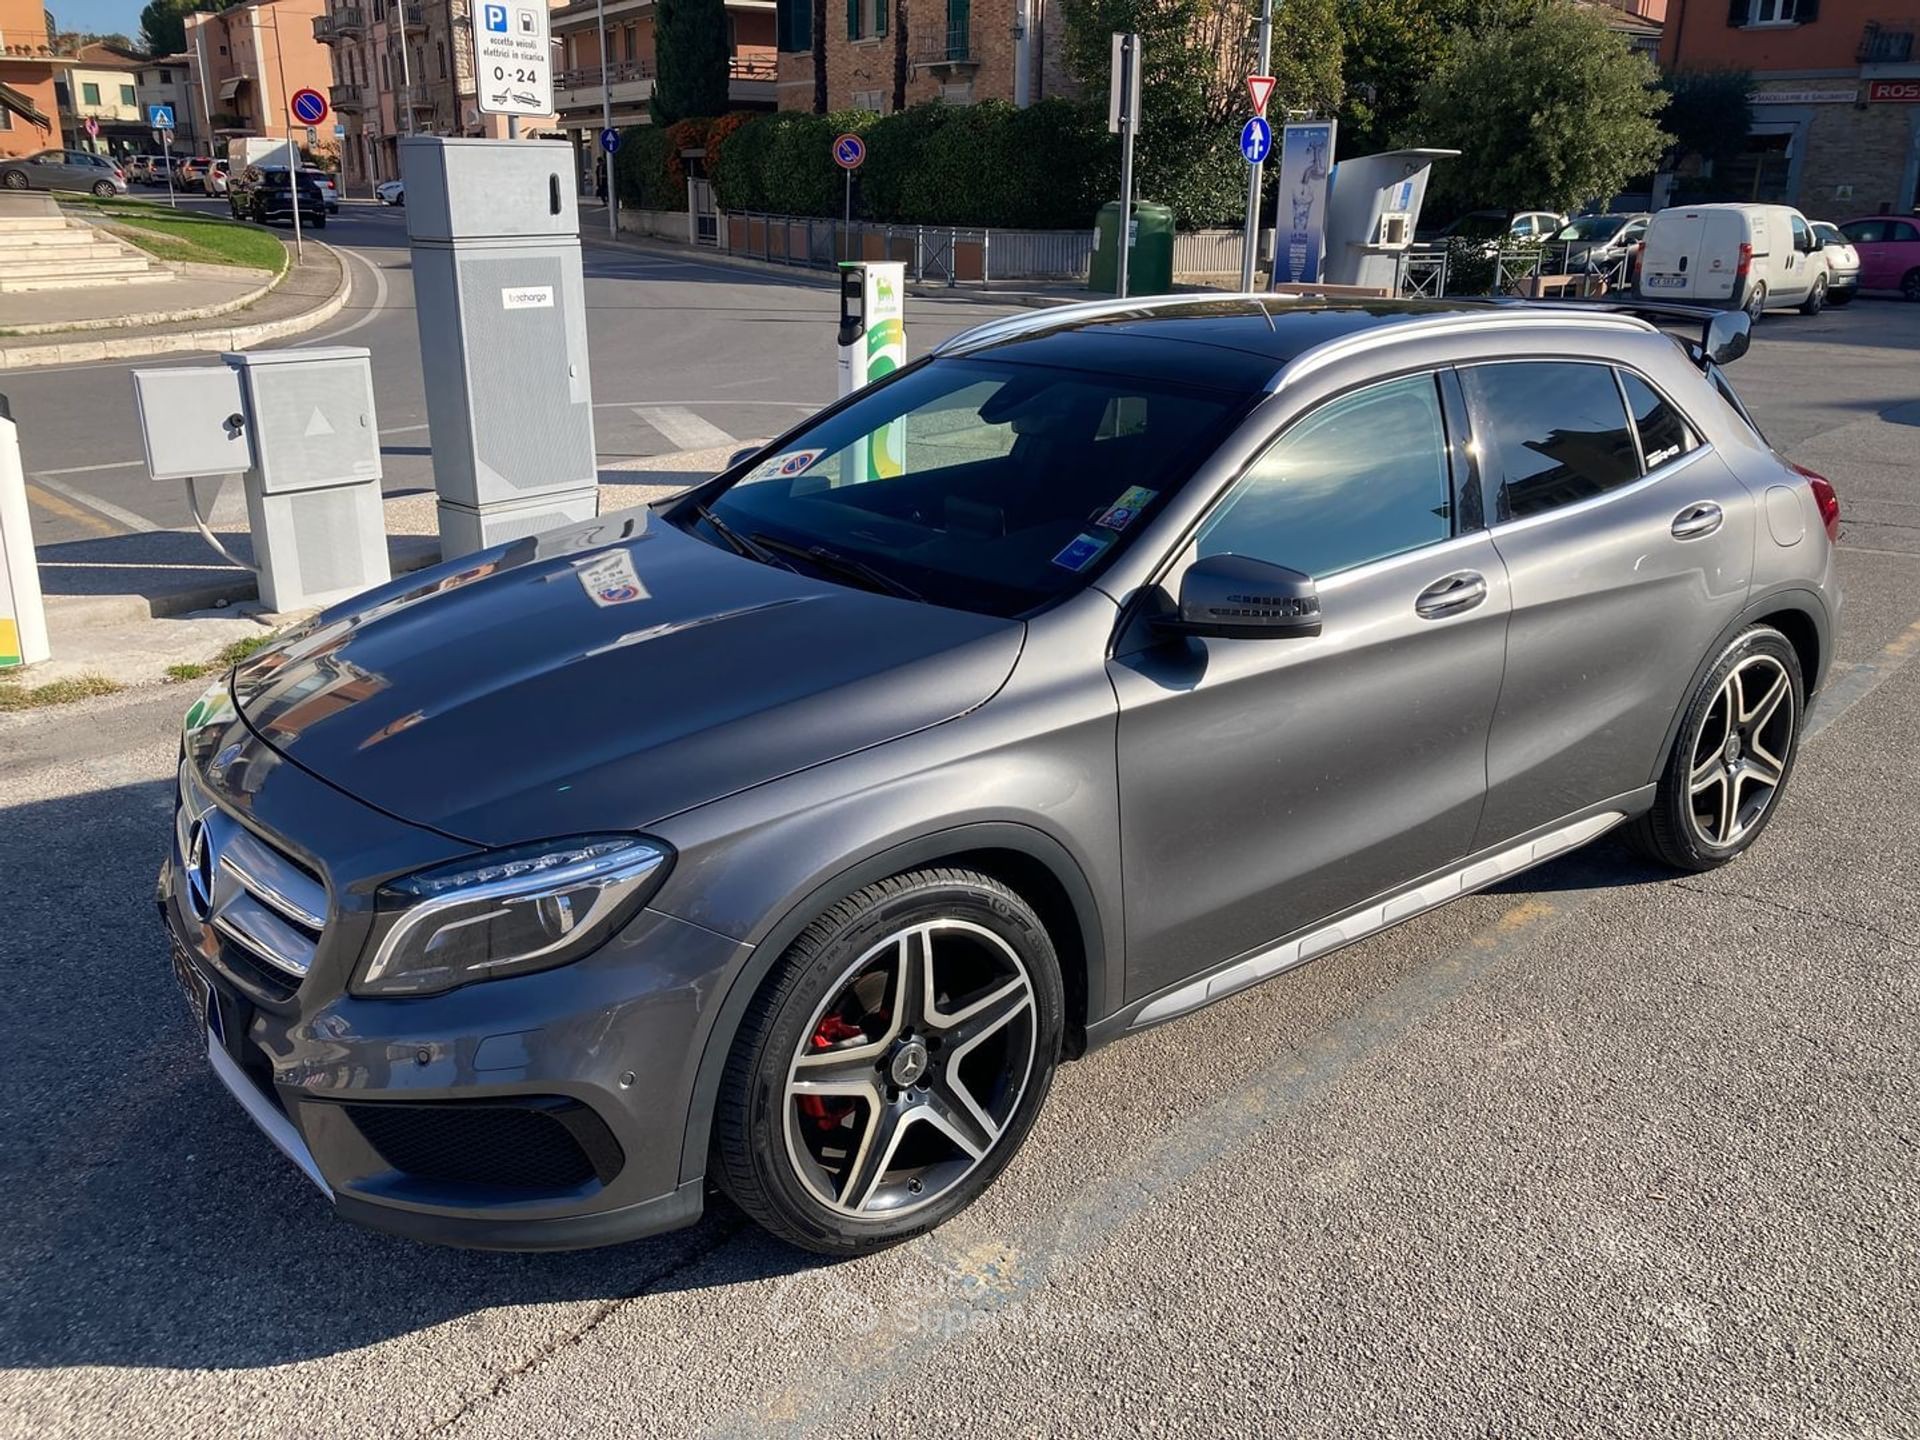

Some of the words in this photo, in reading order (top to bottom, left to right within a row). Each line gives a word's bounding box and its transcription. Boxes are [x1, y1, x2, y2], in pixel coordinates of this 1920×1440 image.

[490, 37, 514, 47] eccetto
[516, 39, 537, 49] veicoli
[483, 47, 510, 58] elettrici
[512, 50, 519, 59] in
[521, 52, 544, 61] ricarica
[1877, 84, 1920, 97] ROS
